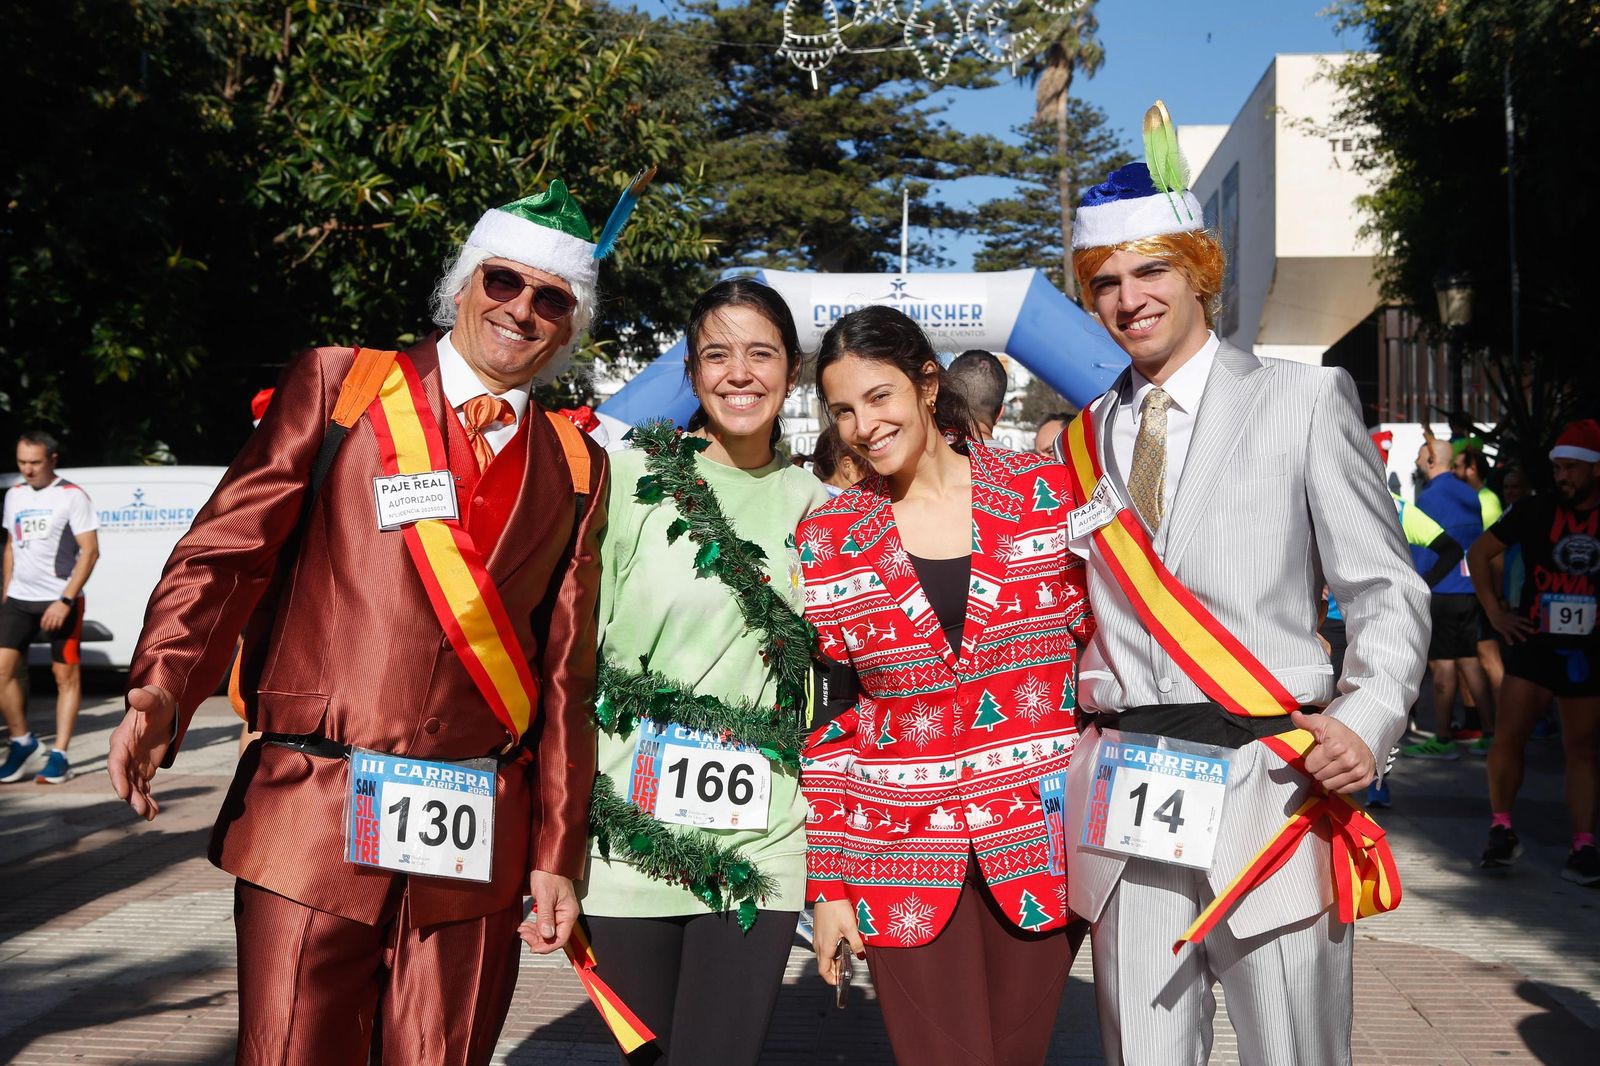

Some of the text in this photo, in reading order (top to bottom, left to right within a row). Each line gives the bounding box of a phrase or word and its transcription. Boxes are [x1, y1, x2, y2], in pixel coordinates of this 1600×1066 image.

[814, 303, 984, 328] CRINISHER
[381, 478, 446, 494] PAJE REAL
[388, 493, 444, 508] AUTORIZADO
[1073, 501, 1097, 519] PAJE
[23, 518, 47, 533] 216
[1560, 607, 1584, 625] 91
[638, 739, 660, 757] SAN
[634, 754, 655, 777] SIL
[1097, 765, 1113, 781] SAN
[1105, 746, 1224, 777] III CARRERA
[361, 759, 490, 789] III CARRERA
[668, 757, 755, 806] 166
[1043, 777, 1061, 792] III
[1144, 763, 1223, 784] TARIFA 2024
[356, 779, 377, 797] SAN
[421, 779, 490, 796] TARIFA 2024
[633, 775, 659, 798] VES
[1093, 780, 1108, 803] SIL
[355, 795, 375, 819] SIL
[1044, 797, 1061, 815] SAN
[1091, 801, 1109, 825] VES
[1129, 782, 1185, 834] 14
[355, 817, 379, 842] VES
[388, 796, 477, 851] 130
[1087, 822, 1106, 847] TRE
[354, 838, 380, 865] TRE
[1052, 833, 1065, 856] VE
